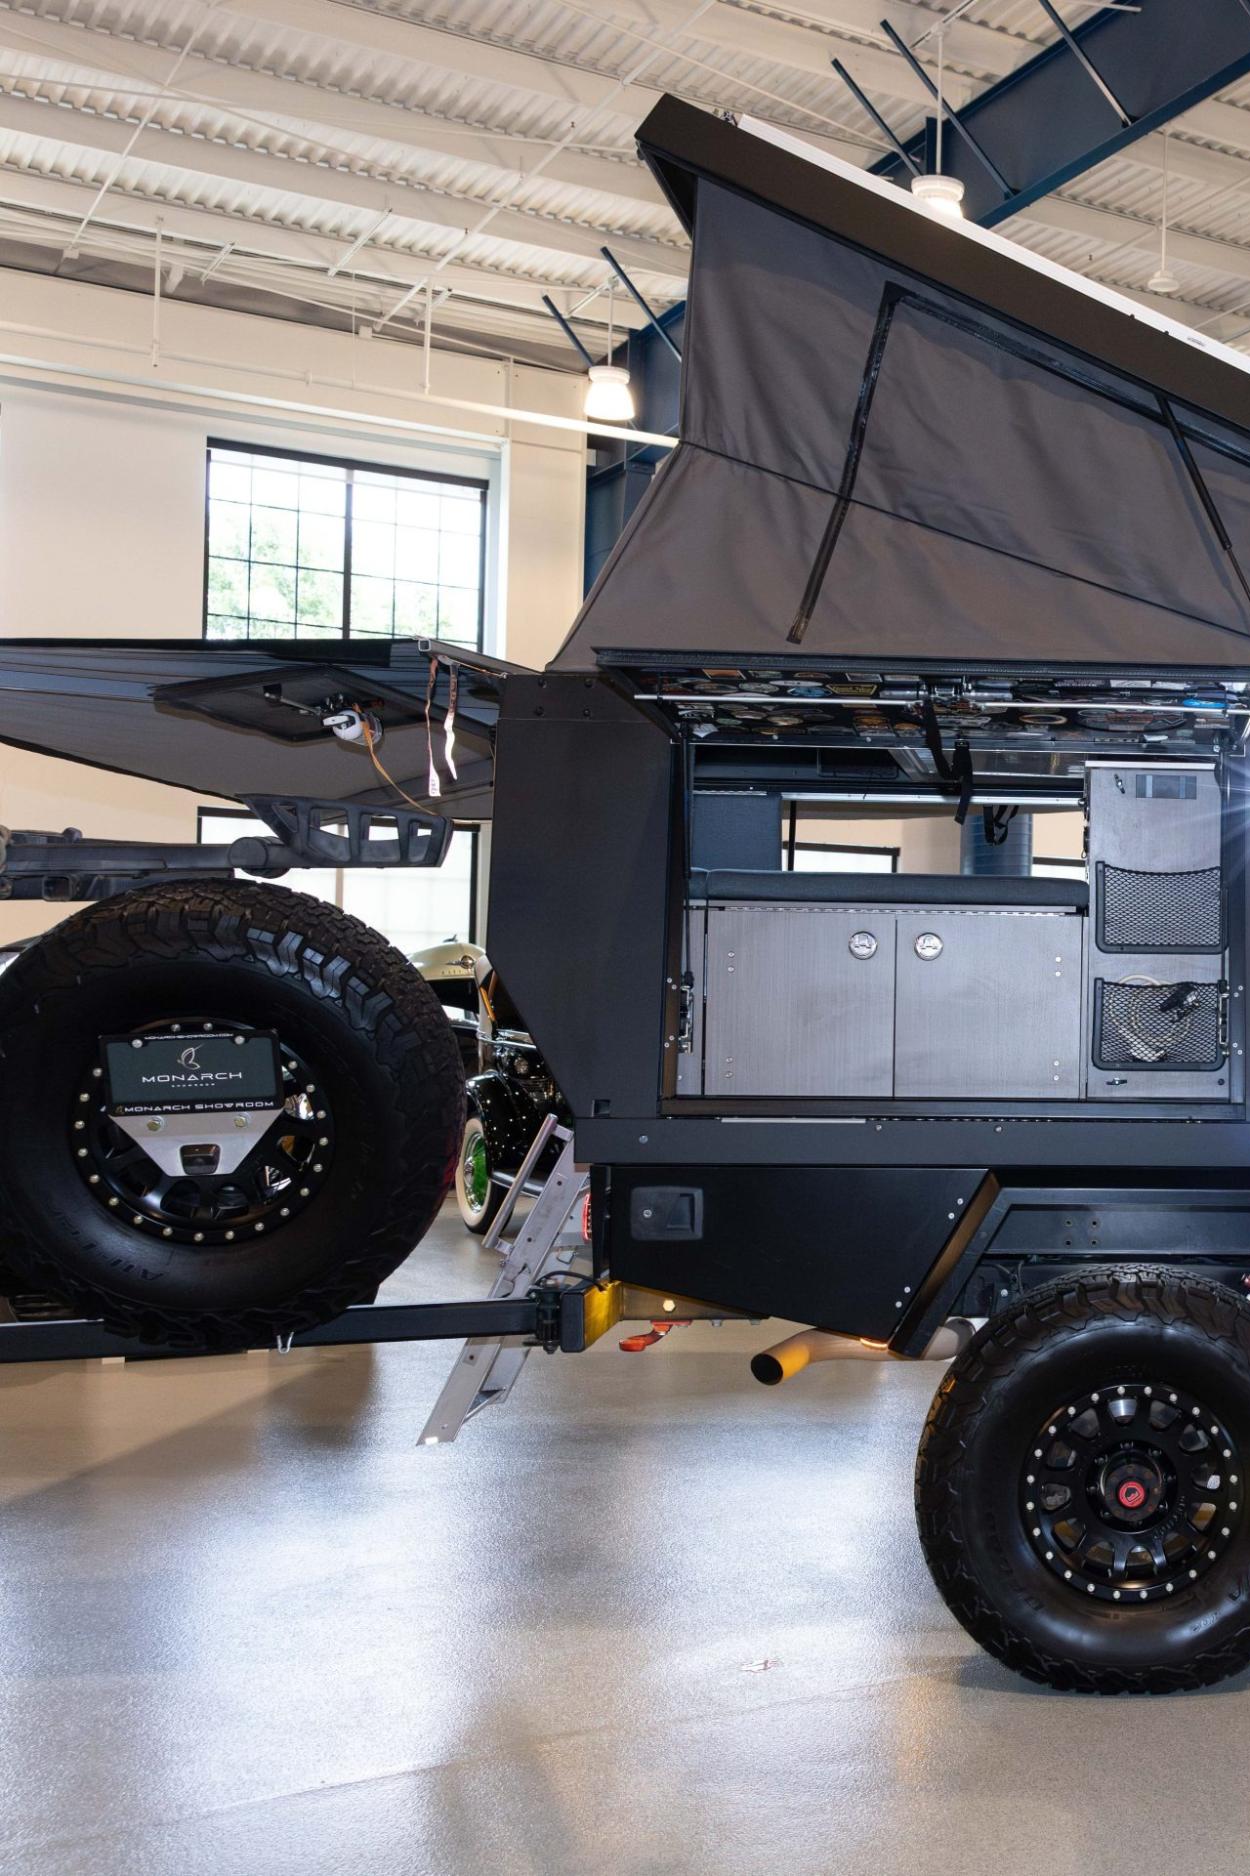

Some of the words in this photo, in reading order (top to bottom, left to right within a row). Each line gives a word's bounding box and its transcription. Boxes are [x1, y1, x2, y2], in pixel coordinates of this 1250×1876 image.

[142, 1072, 242, 1083] MONARCH
[124, 1104, 190, 1112] MONARCH
[194, 1101, 274, 1110] SHOWROOM
